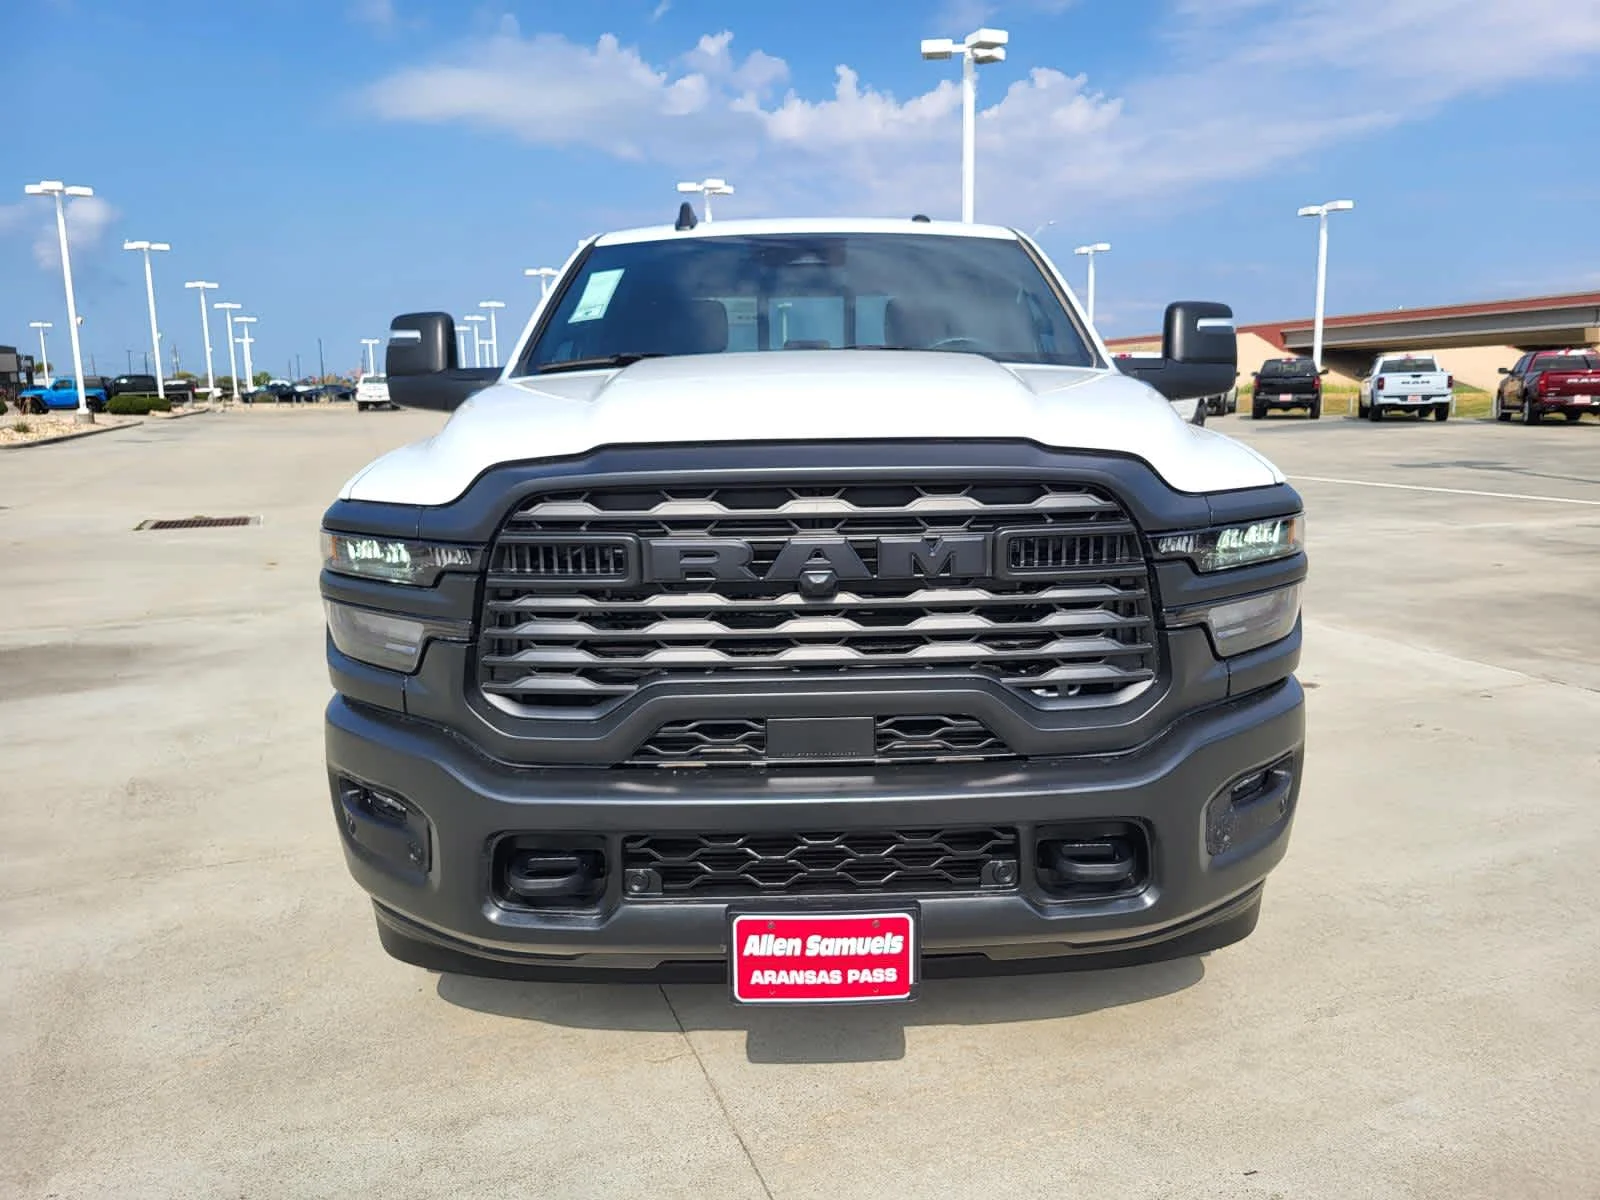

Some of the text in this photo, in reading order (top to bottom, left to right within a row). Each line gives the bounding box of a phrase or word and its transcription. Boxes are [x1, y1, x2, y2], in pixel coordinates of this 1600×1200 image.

[645, 536, 993, 581] RAM
[743, 932, 904, 957] Allen Samuels
[750, 967, 898, 985] ARANSAS PASS
